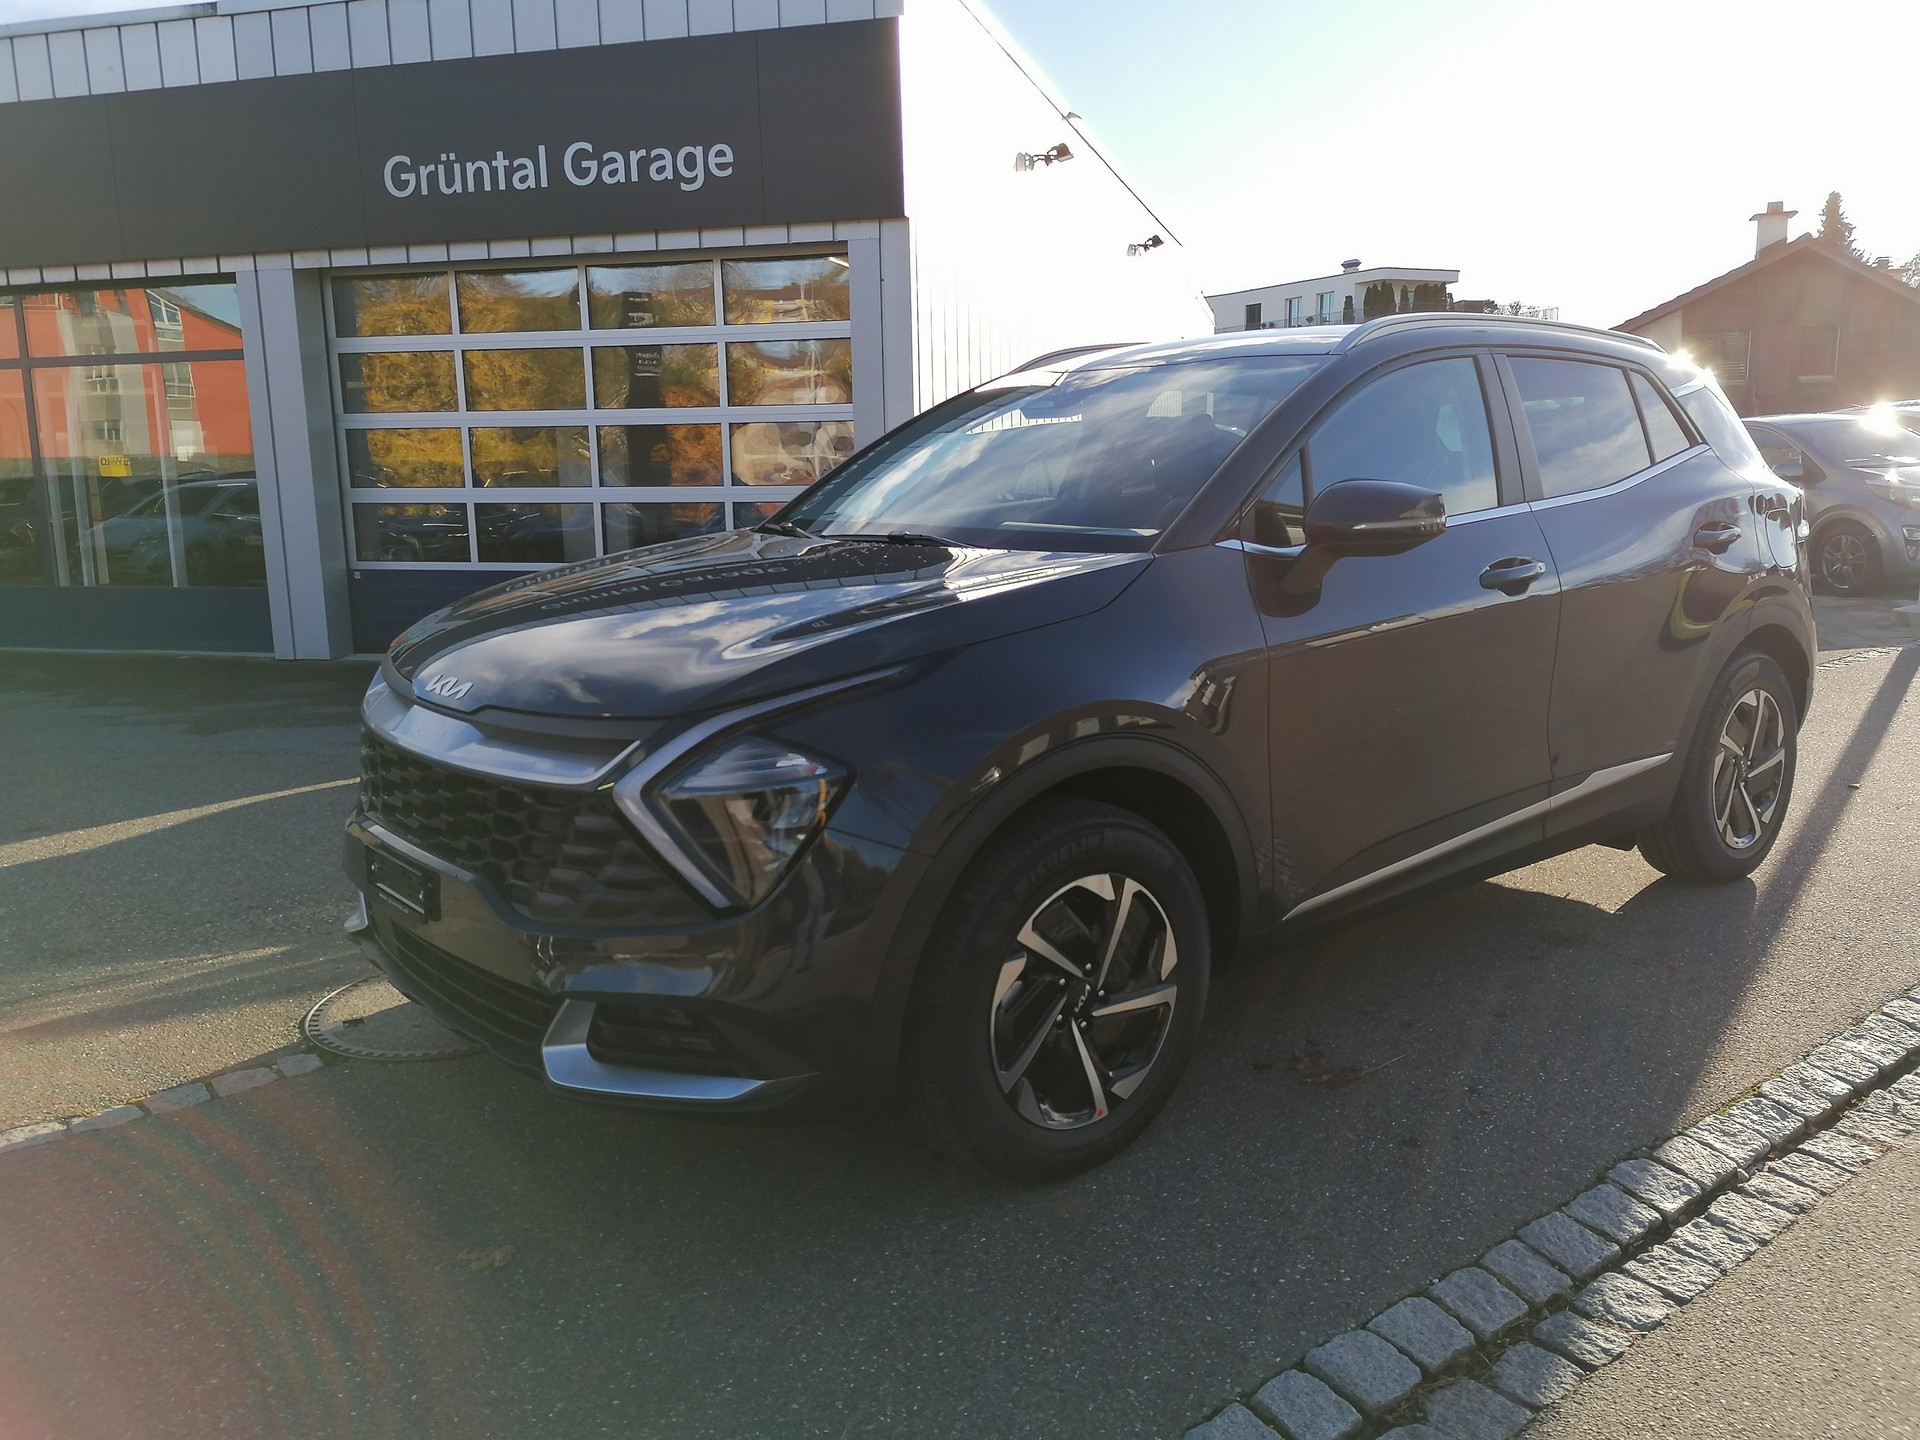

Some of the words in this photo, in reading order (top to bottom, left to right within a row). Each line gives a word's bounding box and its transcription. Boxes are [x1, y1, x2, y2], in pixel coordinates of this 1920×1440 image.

[383, 144, 549, 198] Grüntal
[563, 141, 735, 192] Garage
[425, 674, 474, 700] KIA
